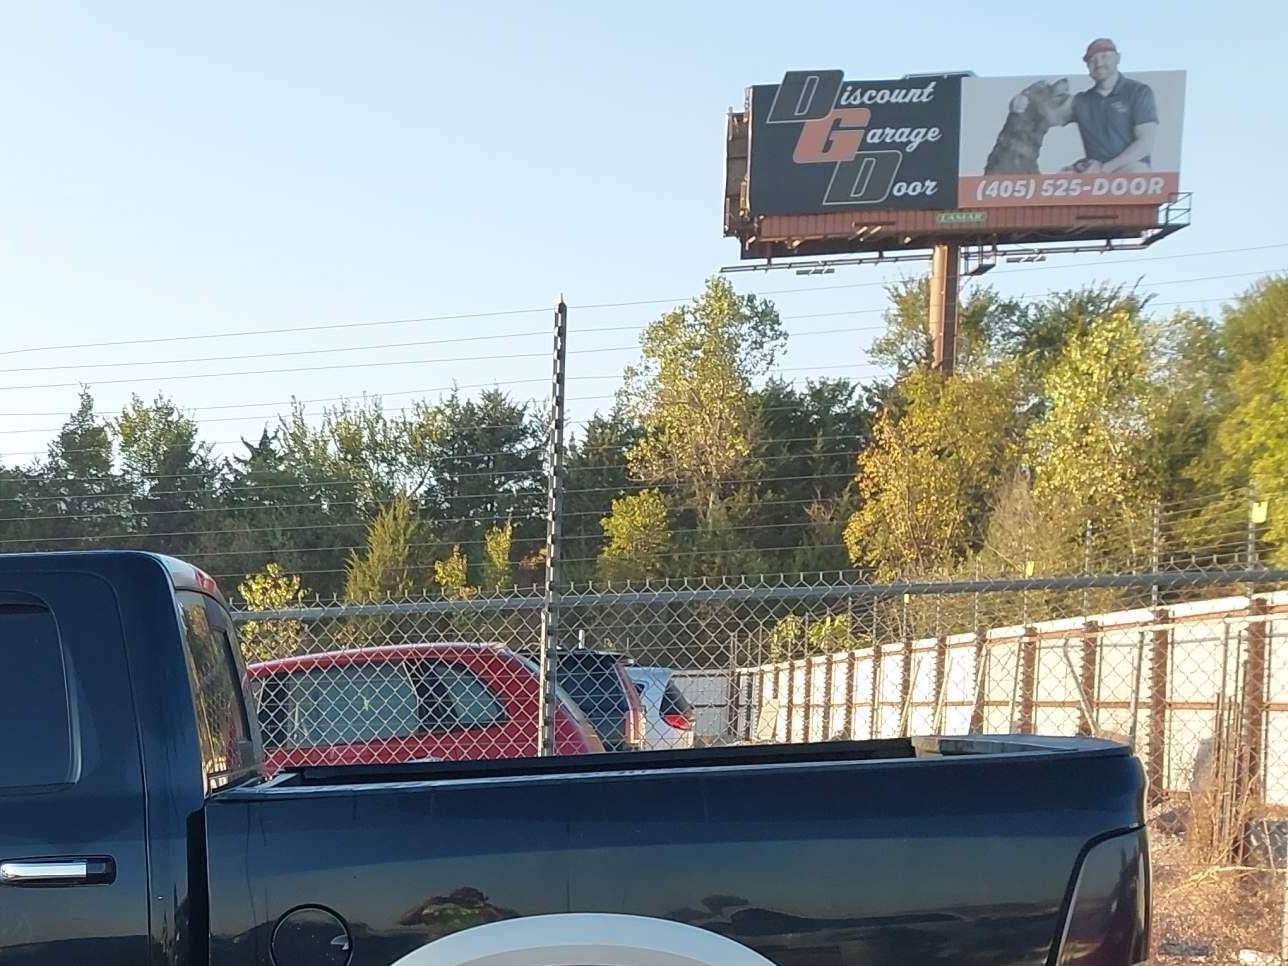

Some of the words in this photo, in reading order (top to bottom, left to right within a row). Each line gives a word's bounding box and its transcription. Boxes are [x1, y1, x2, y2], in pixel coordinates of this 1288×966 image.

[766, 69, 937, 124] Discount
[792, 107, 942, 164] Garage
[822, 149, 938, 206] Door
[976, 179, 1035, 201] (405)
[1041, 176, 1165, 197] 525-DOOR
